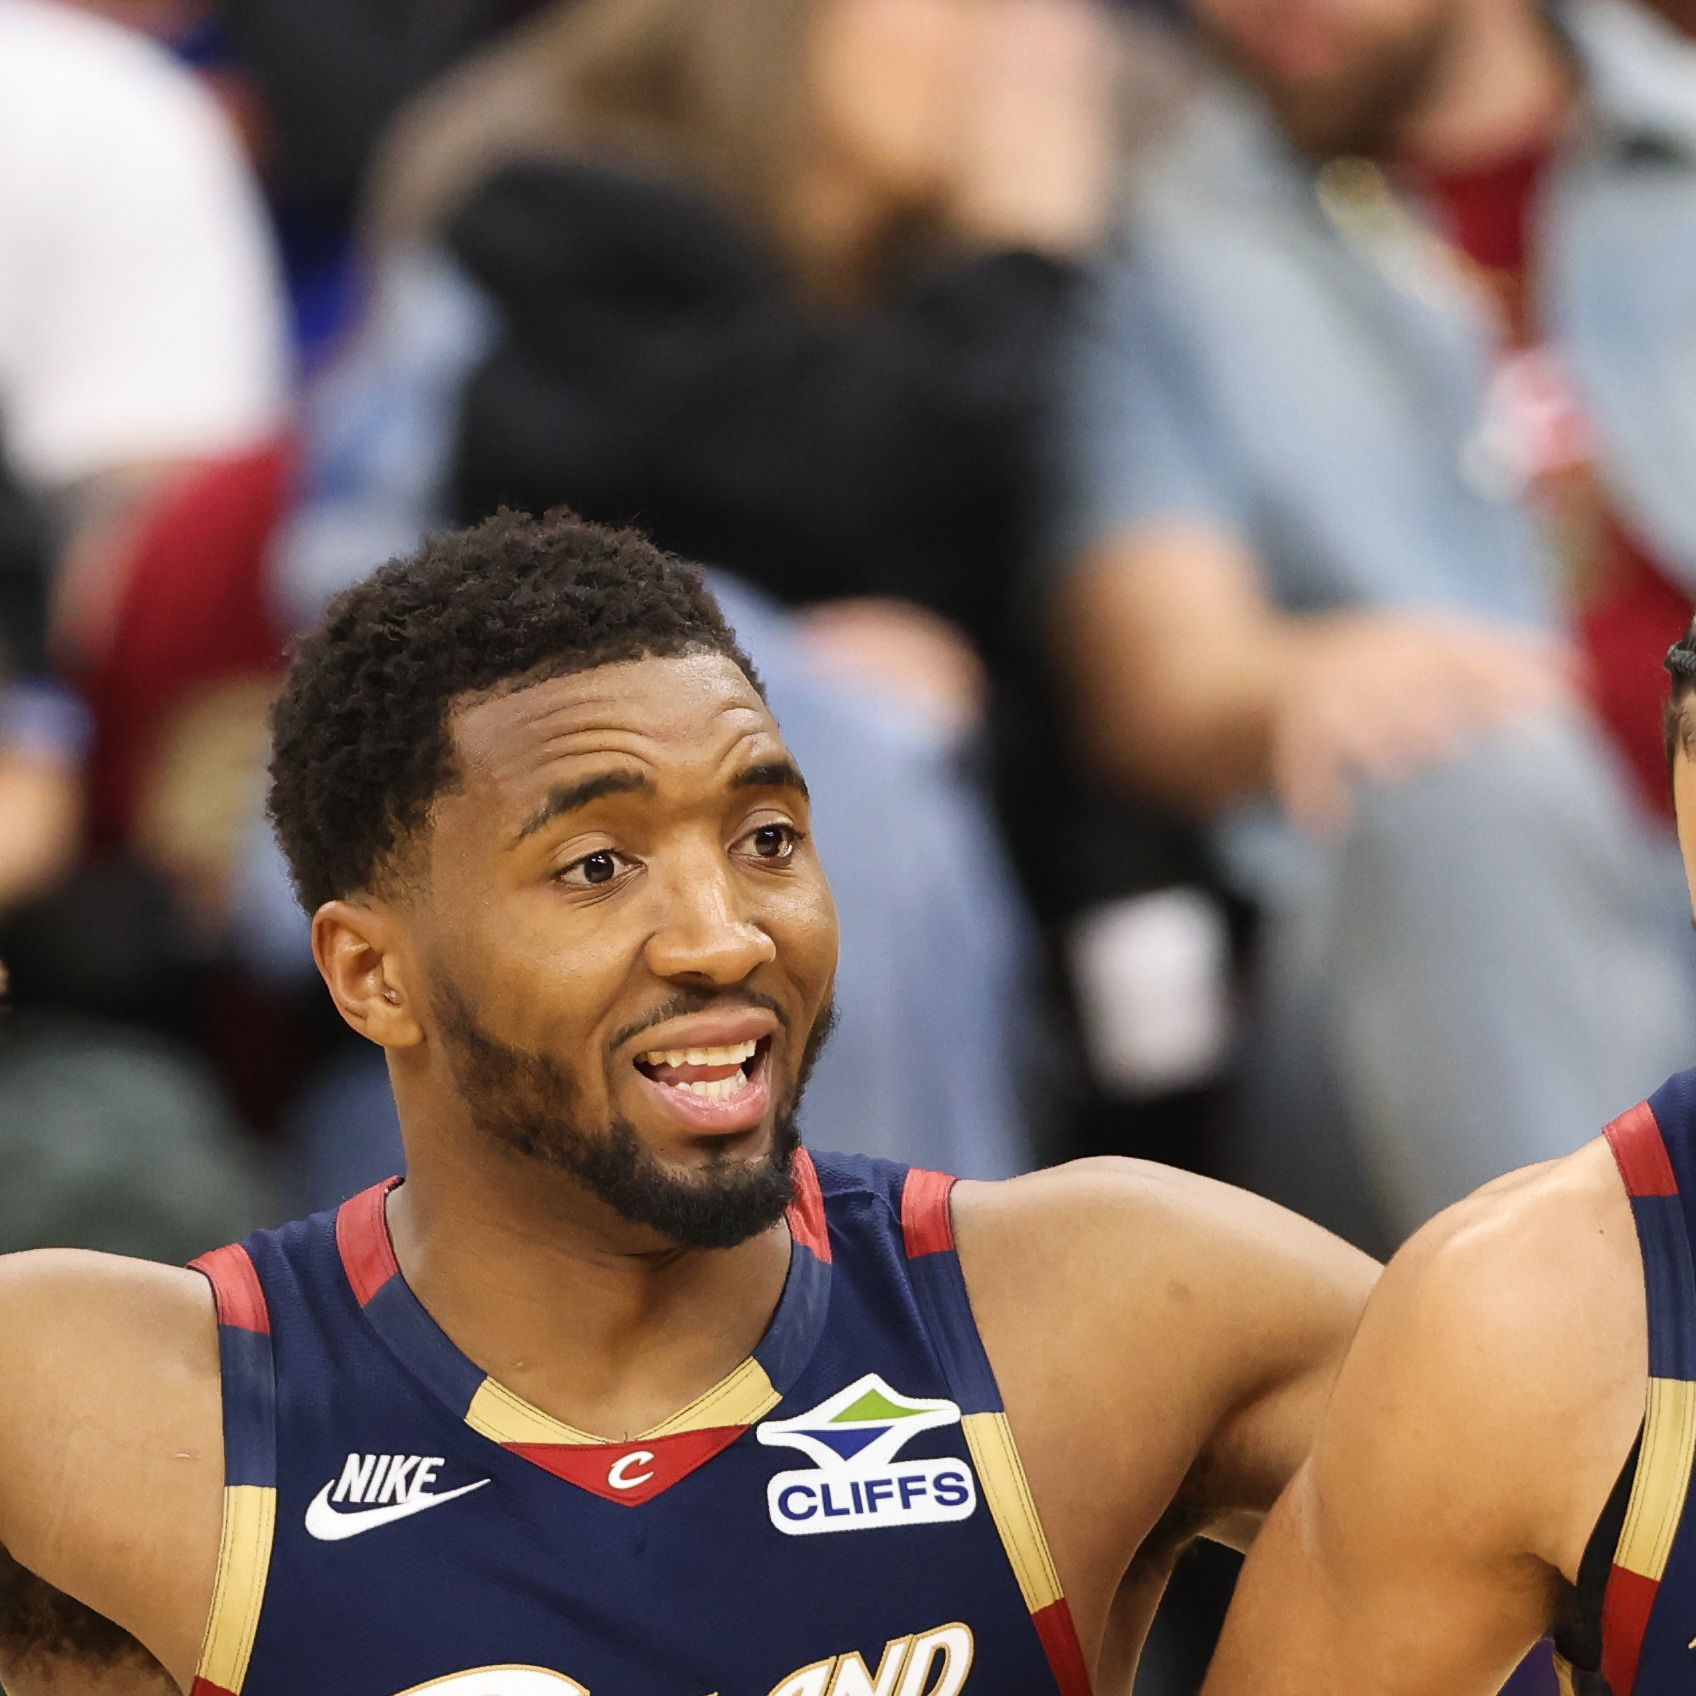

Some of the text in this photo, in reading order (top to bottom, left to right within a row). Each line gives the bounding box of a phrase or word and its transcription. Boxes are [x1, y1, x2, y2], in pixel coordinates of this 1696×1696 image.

[331, 1453, 446, 1504] NIKE
[607, 1450, 655, 1490] C
[776, 1470, 970, 1522] CLIFFS
